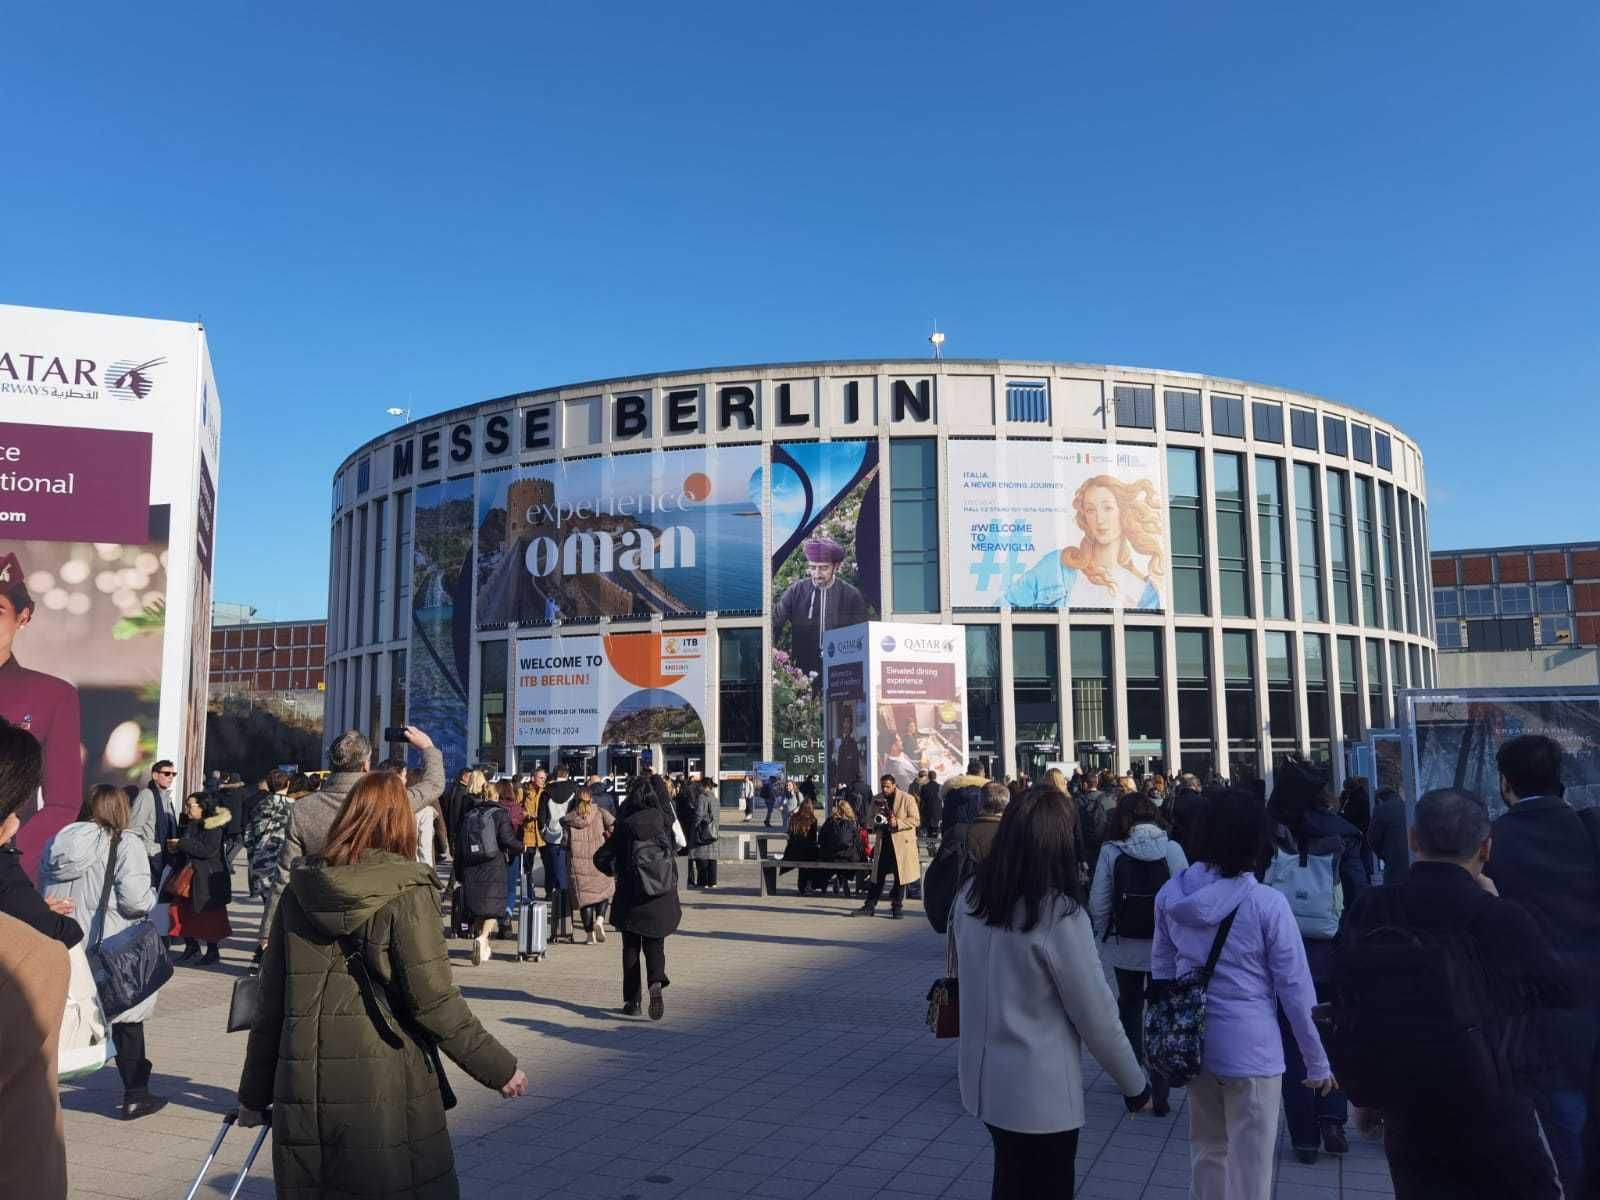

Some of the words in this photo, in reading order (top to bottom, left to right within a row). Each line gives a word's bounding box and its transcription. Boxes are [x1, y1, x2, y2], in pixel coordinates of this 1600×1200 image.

[393, 408, 550, 480] MESSE
[616, 380, 930, 437] BERLIN
[526, 489, 696, 529] experience
[971, 523, 1033, 533] #WELCOME
[970, 533, 986, 542] TO
[525, 526, 696, 577] oman
[971, 543, 1036, 552] MERAVIGLIA
[683, 638, 698, 646] ITB
[904, 638, 940, 650] QATAR
[520, 656, 582, 670] WELCOME
[585, 655, 603, 667] TO
[520, 675, 538, 687] ITB
[541, 674, 590, 687] BERLIN!
[518, 727, 523, 735] 5
[529, 727, 534, 735] 7
[535, 727, 561, 735] MARCH
[562, 726, 579, 735] 2024
[782, 737, 808, 749] Eine
[793, 754, 815, 764] ans
